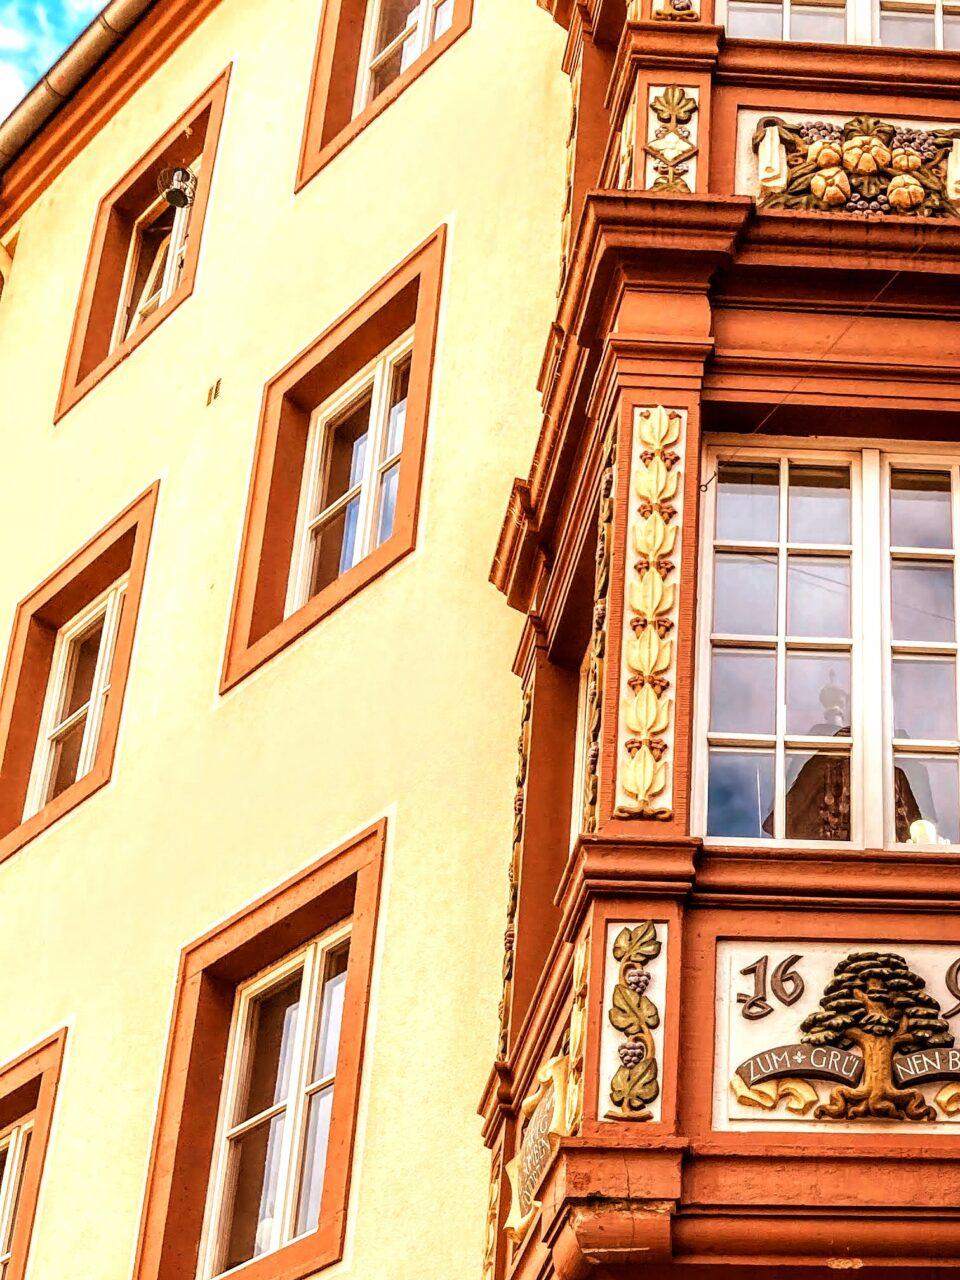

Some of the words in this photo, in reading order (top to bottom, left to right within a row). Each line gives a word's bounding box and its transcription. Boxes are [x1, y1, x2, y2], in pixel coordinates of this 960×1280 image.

[737, 955, 805, 1020] 16
[748, 1051, 791, 1082] ZUM
[810, 1048, 862, 1078] GRÜ
[895, 1052, 941, 1080] NEN
